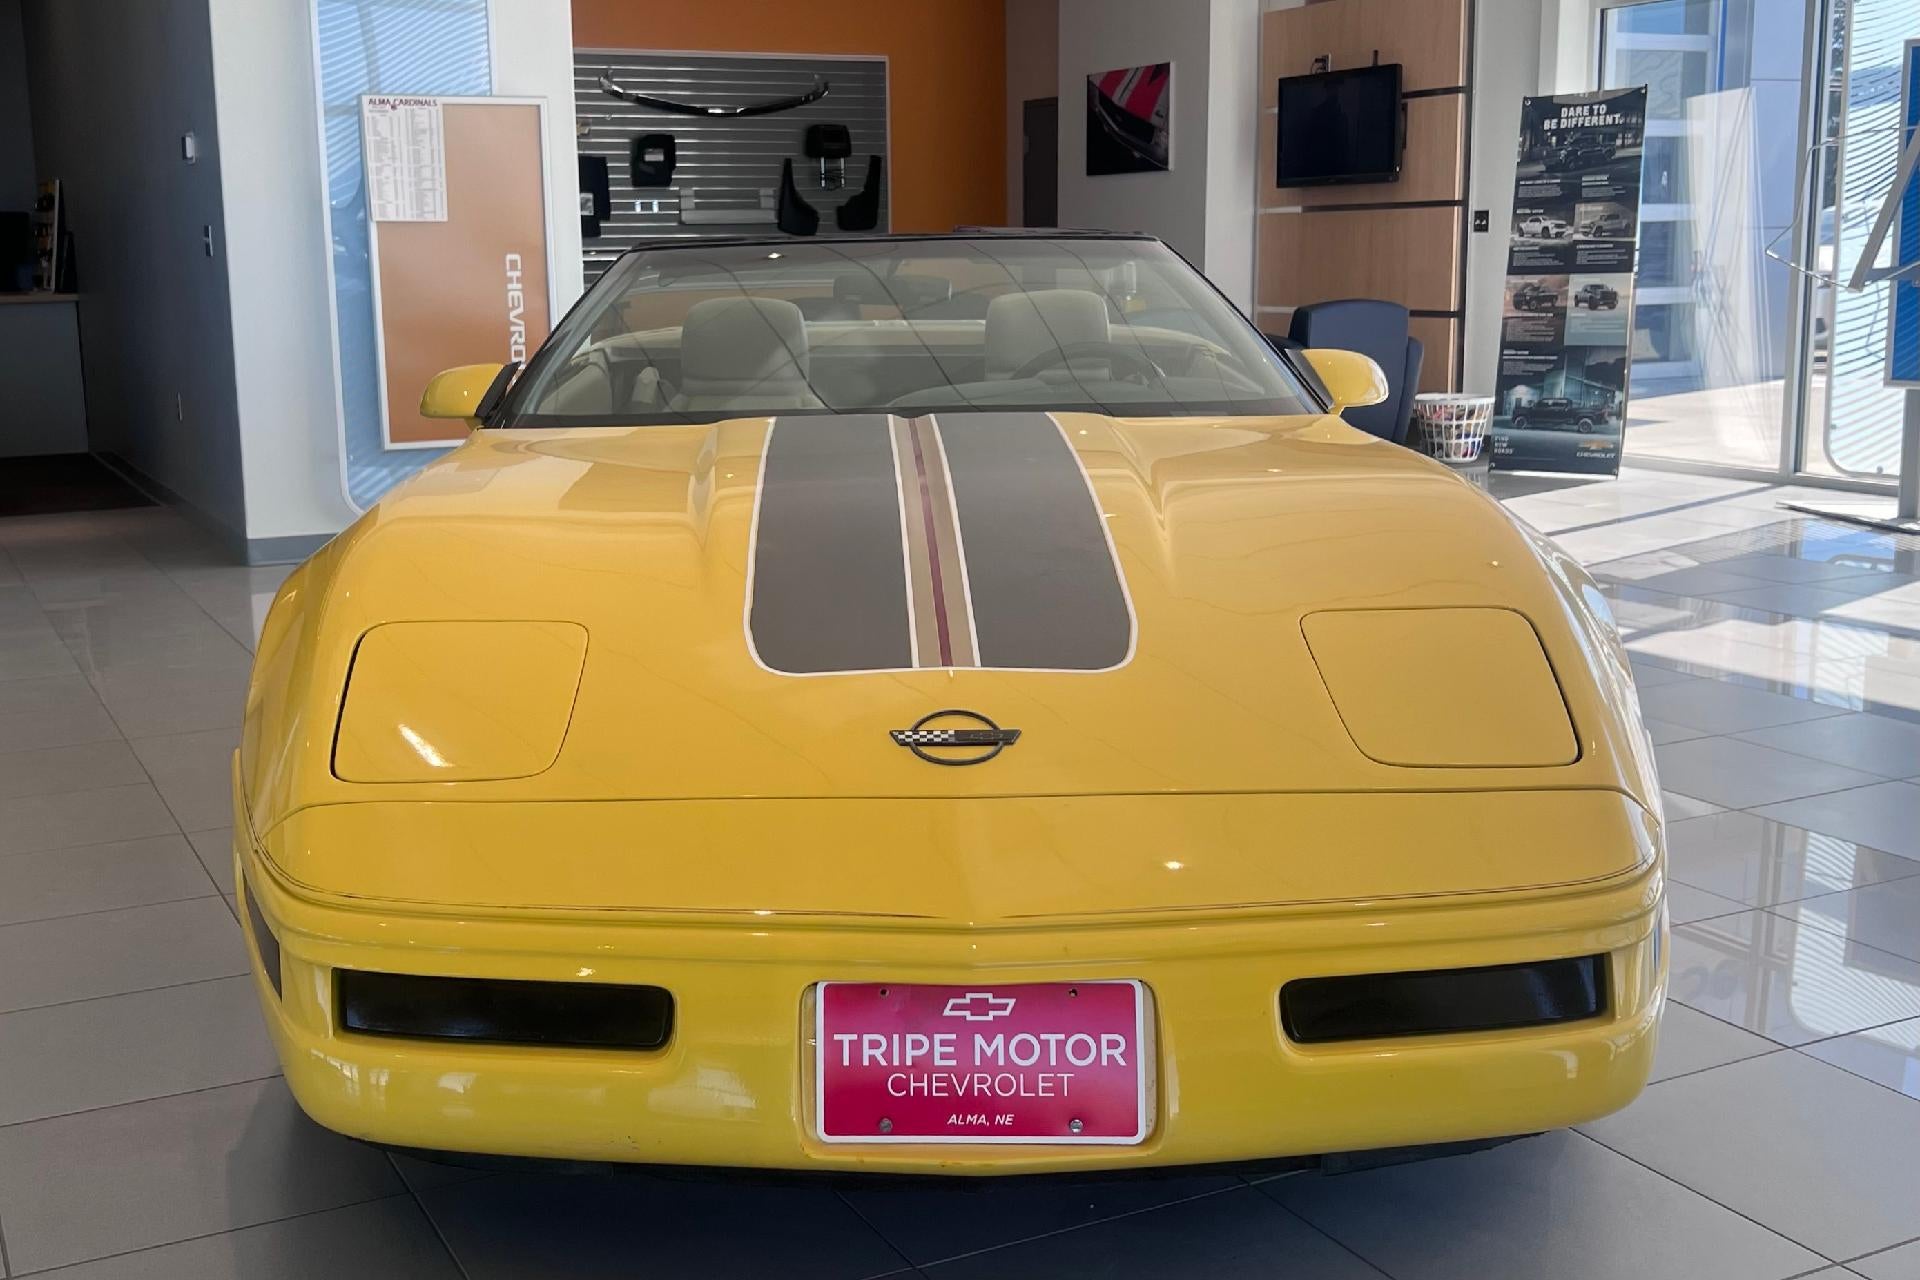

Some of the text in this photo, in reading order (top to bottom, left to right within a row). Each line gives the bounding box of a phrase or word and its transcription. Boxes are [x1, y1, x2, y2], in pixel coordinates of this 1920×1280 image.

[368, 98, 438, 107] ALMA CARDINALS
[1561, 103, 1607, 118] DARE TO
[1543, 118, 1559, 130] BE
[505, 253, 527, 369] CHEVRO
[833, 1033, 1127, 1067] TRIPE MOTOR
[887, 1073, 1074, 1097] CHEVROLET
[947, 1113, 1015, 1127] ALMA, NE
